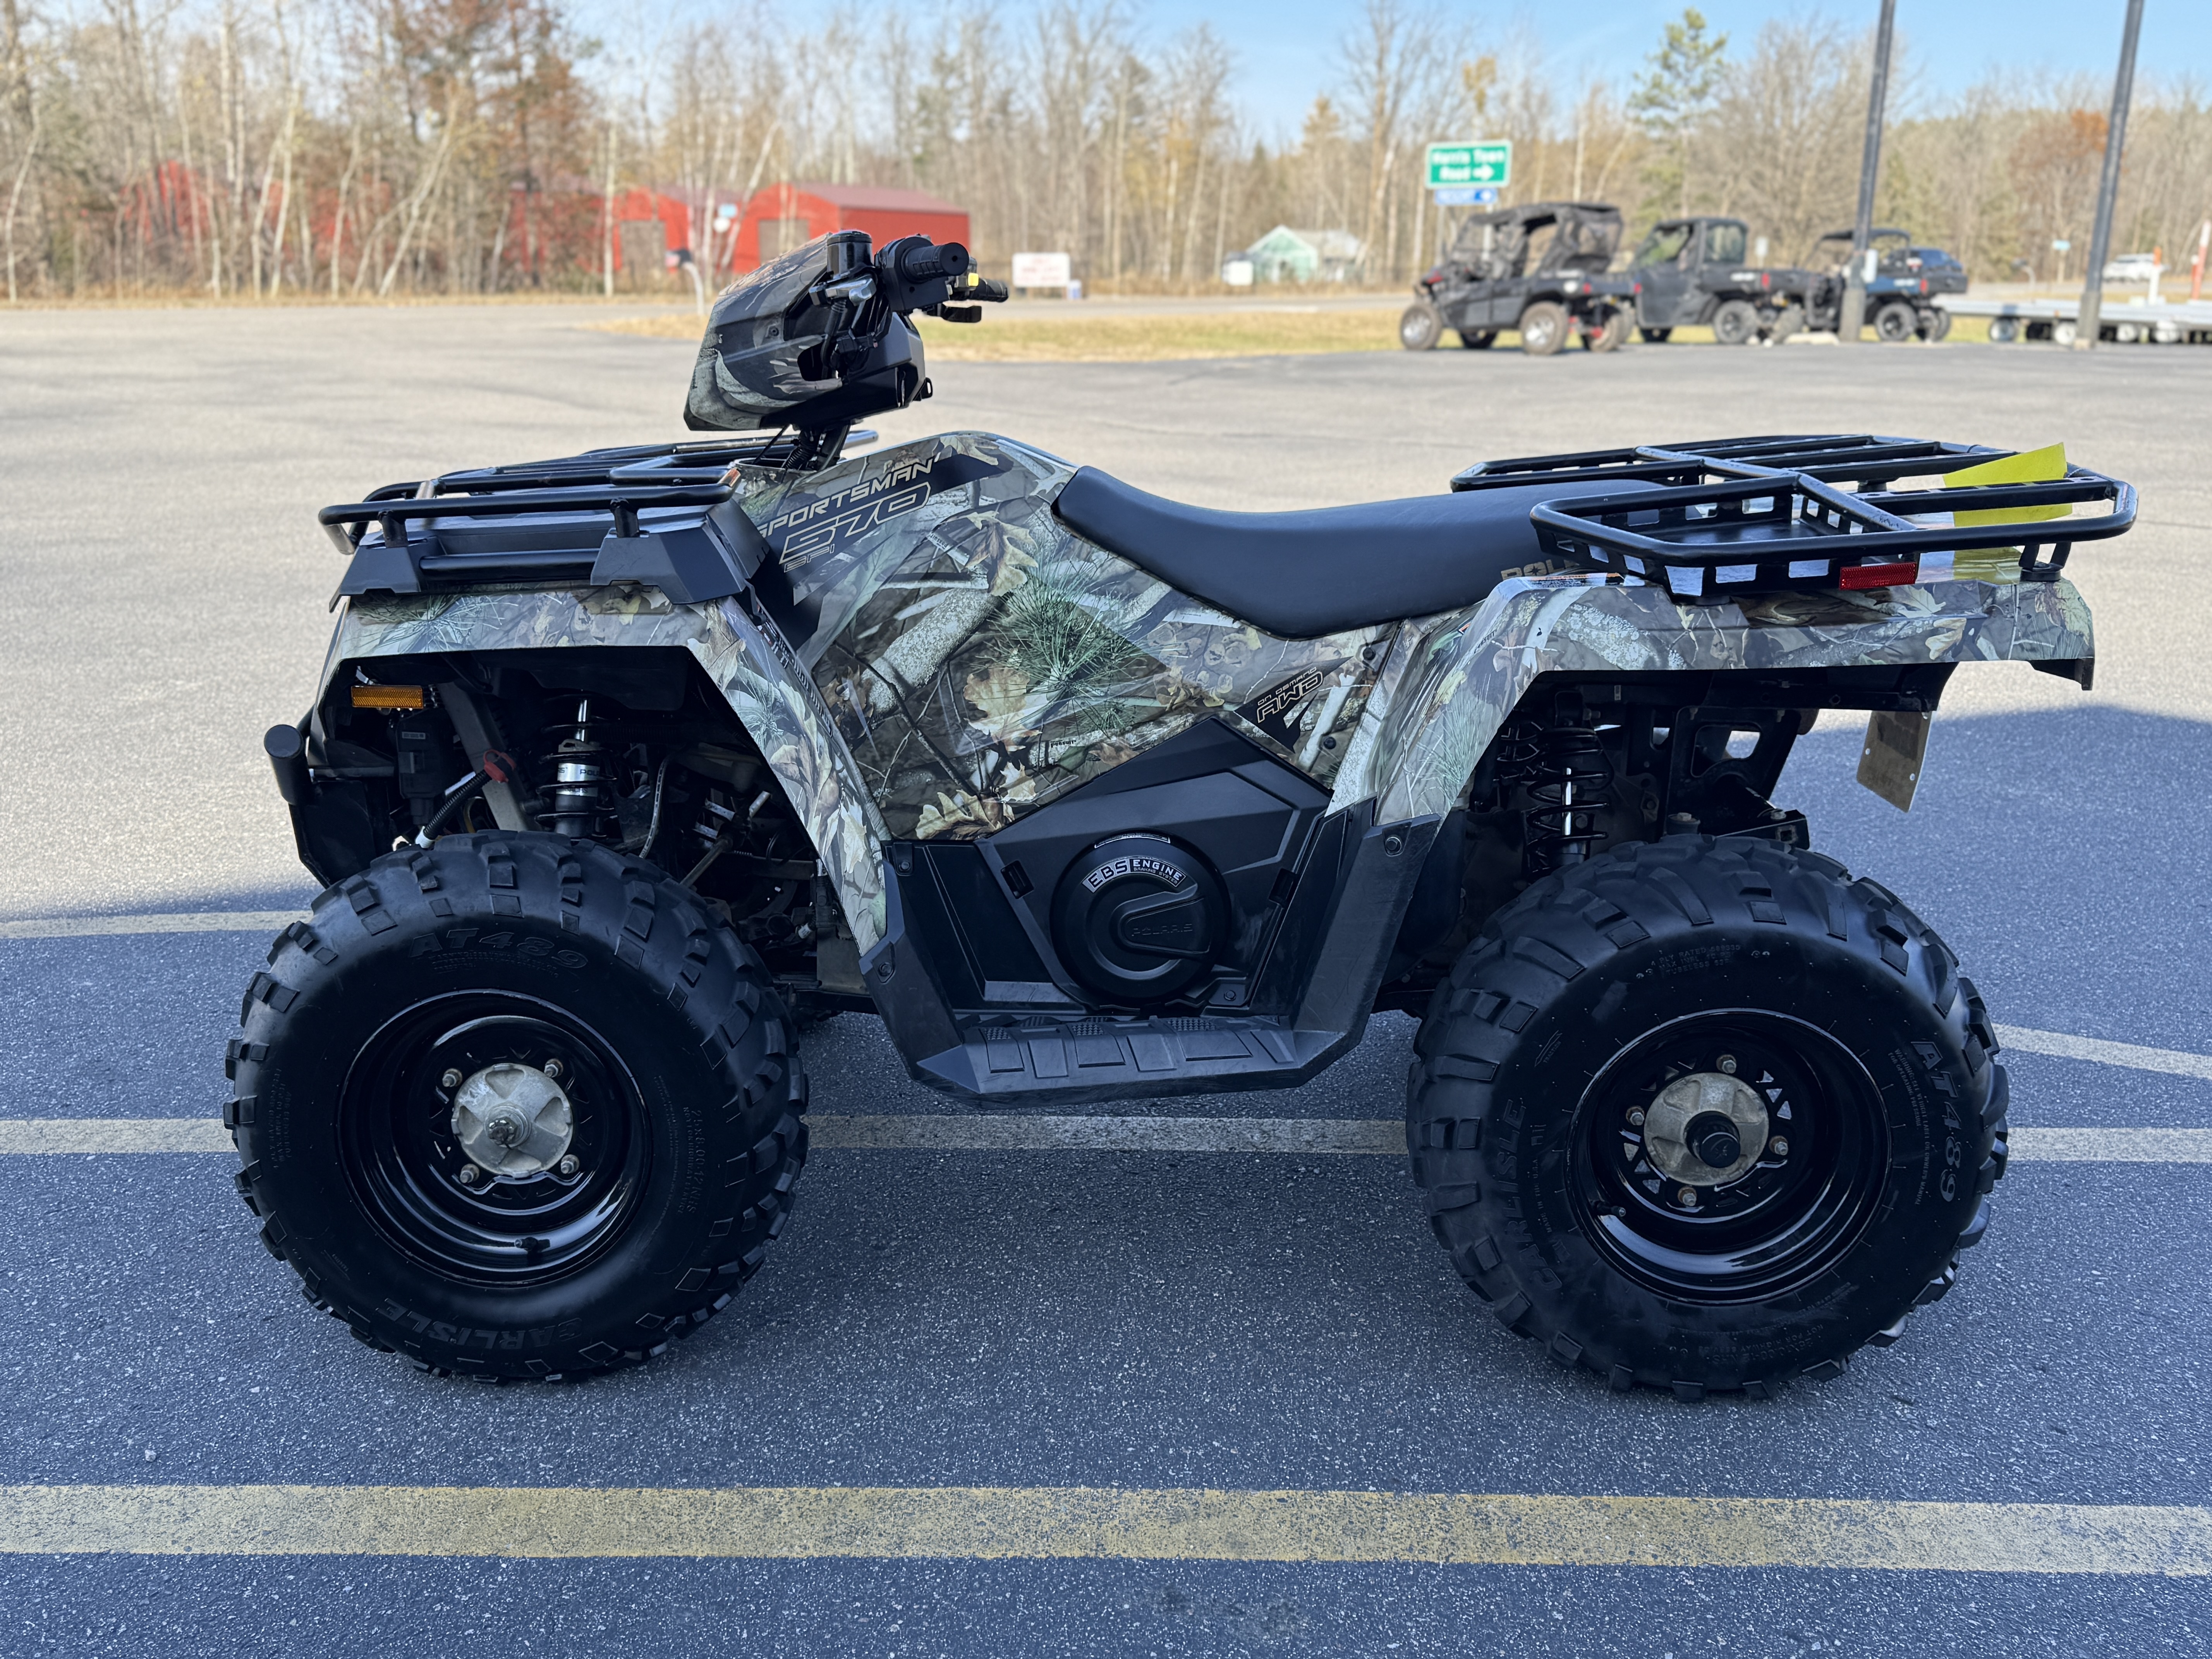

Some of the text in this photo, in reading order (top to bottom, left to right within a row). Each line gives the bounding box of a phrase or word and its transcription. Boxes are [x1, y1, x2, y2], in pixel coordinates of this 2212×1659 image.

[757, 459, 933, 538] SPORTSMAN
[779, 482, 931, 565] 570
[1257, 671, 1323, 723] AWD
[1088, 859, 1182, 888] EBS ENGINE
[1158, 872, 1178, 884] SYSTEM
[408, 927, 588, 969] AT489
[1132, 923, 1193, 936] POLARIS
[1678, 947, 1707, 958] RATED
[1910, 1041, 1963, 1202] AT489
[1499, 1098, 1563, 1290] CARLISLE
[375, 1297, 584, 1350] CARLISLE
